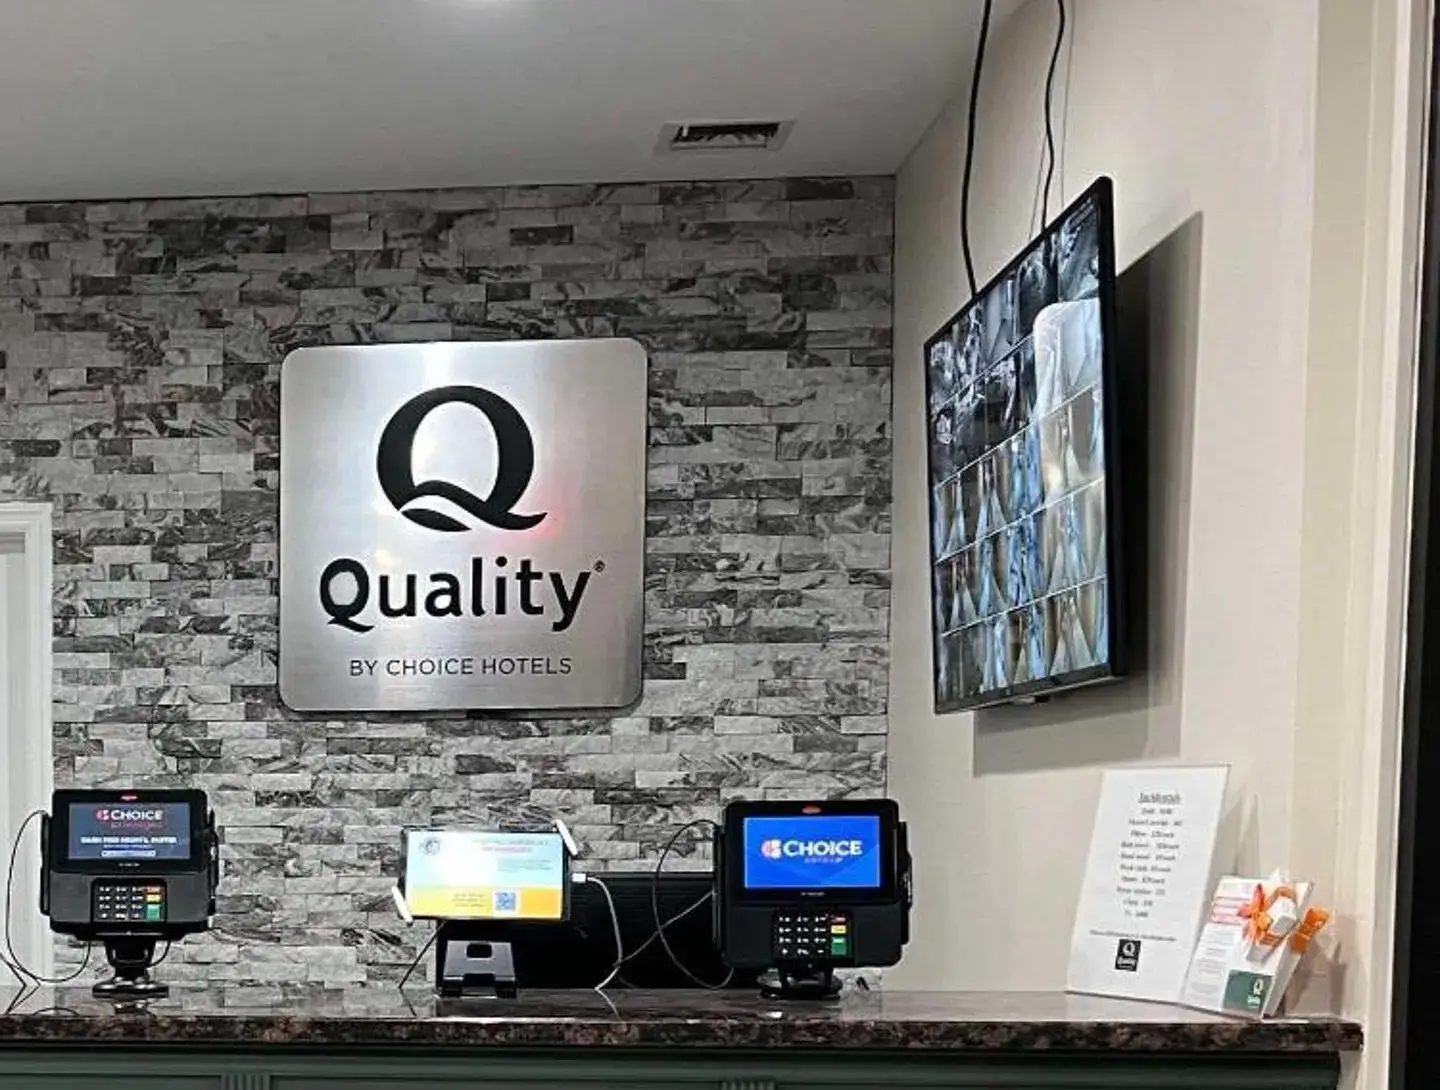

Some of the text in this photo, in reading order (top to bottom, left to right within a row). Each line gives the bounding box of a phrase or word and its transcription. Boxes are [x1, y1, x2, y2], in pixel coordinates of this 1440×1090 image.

[349, 658, 572, 676] BY CHOICE HOTELS
[111, 809, 163, 820] CHOICE
[783, 840, 863, 857] CHOICE
